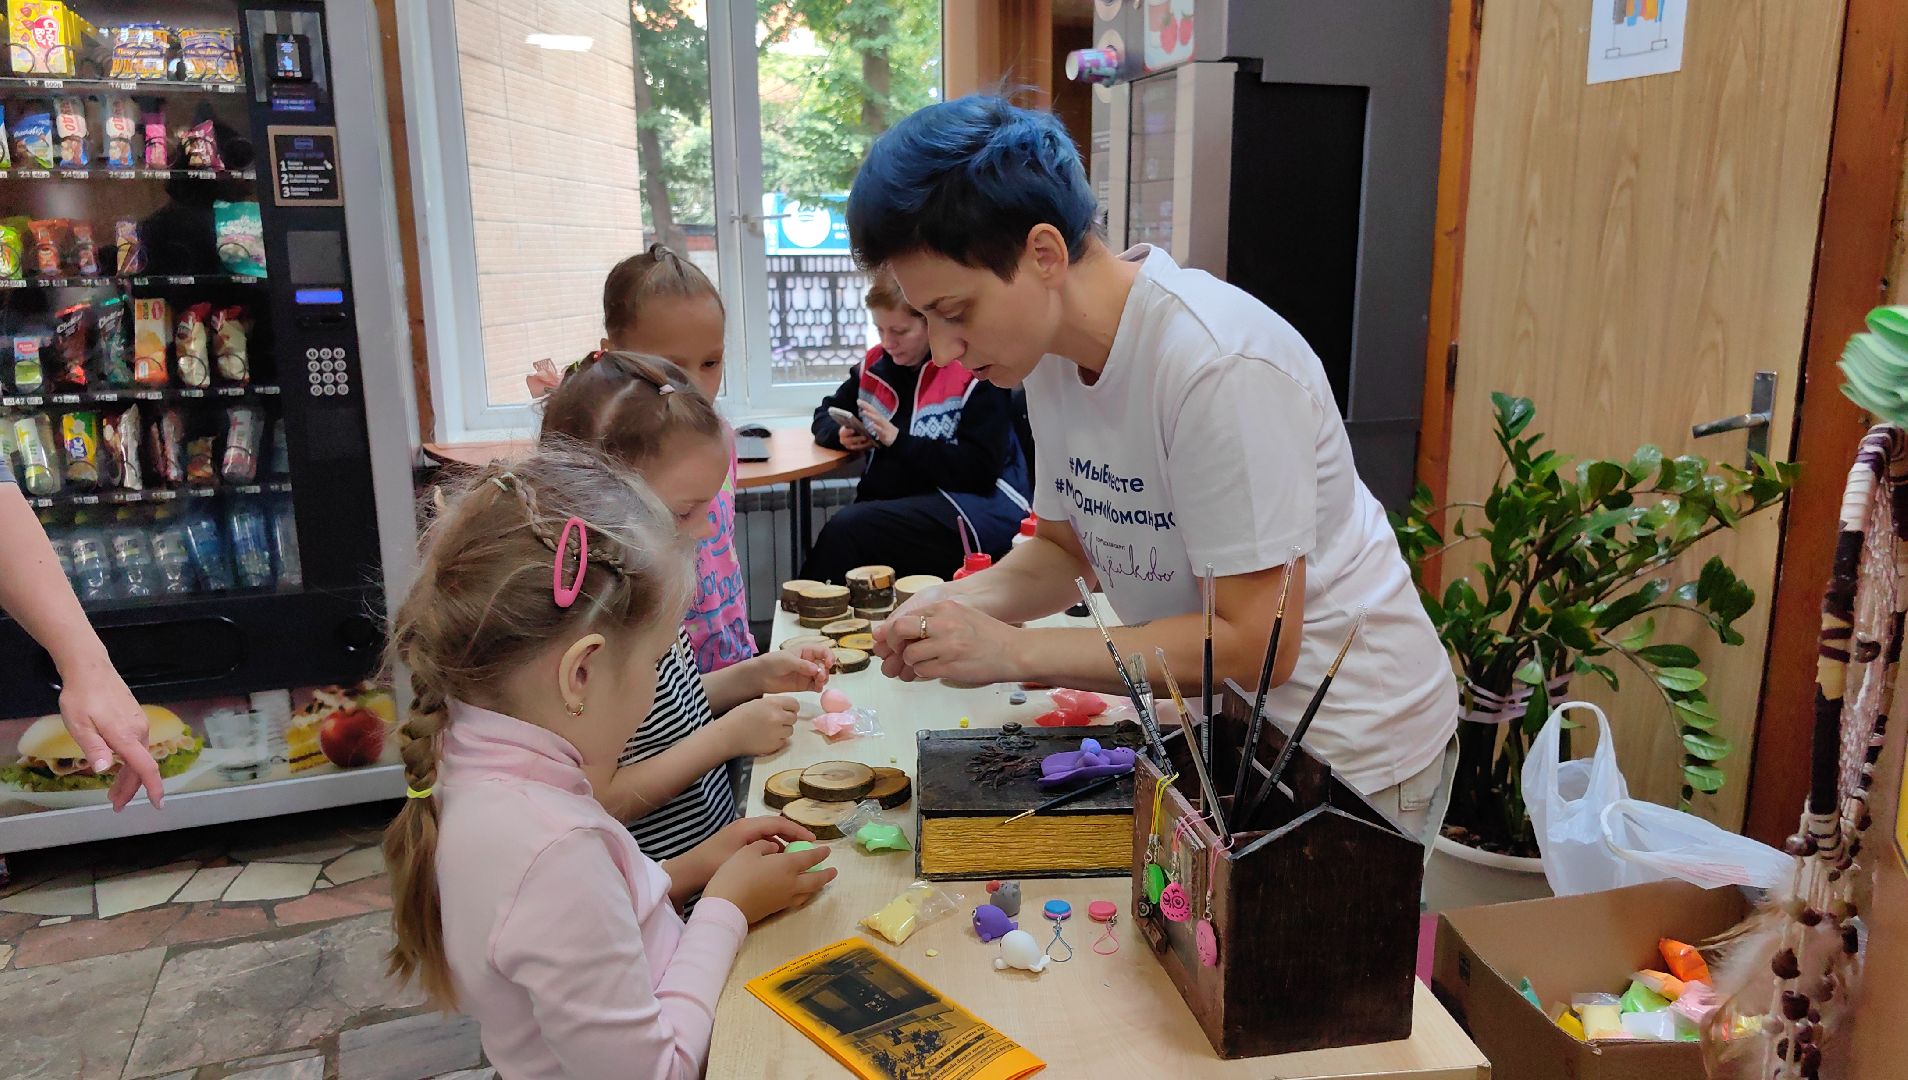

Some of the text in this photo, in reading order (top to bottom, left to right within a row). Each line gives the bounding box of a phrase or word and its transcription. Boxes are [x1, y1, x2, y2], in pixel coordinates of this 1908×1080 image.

[280, 160, 288, 171] 1
[281, 174, 289, 184] 2
[282, 186, 290, 197] 3
